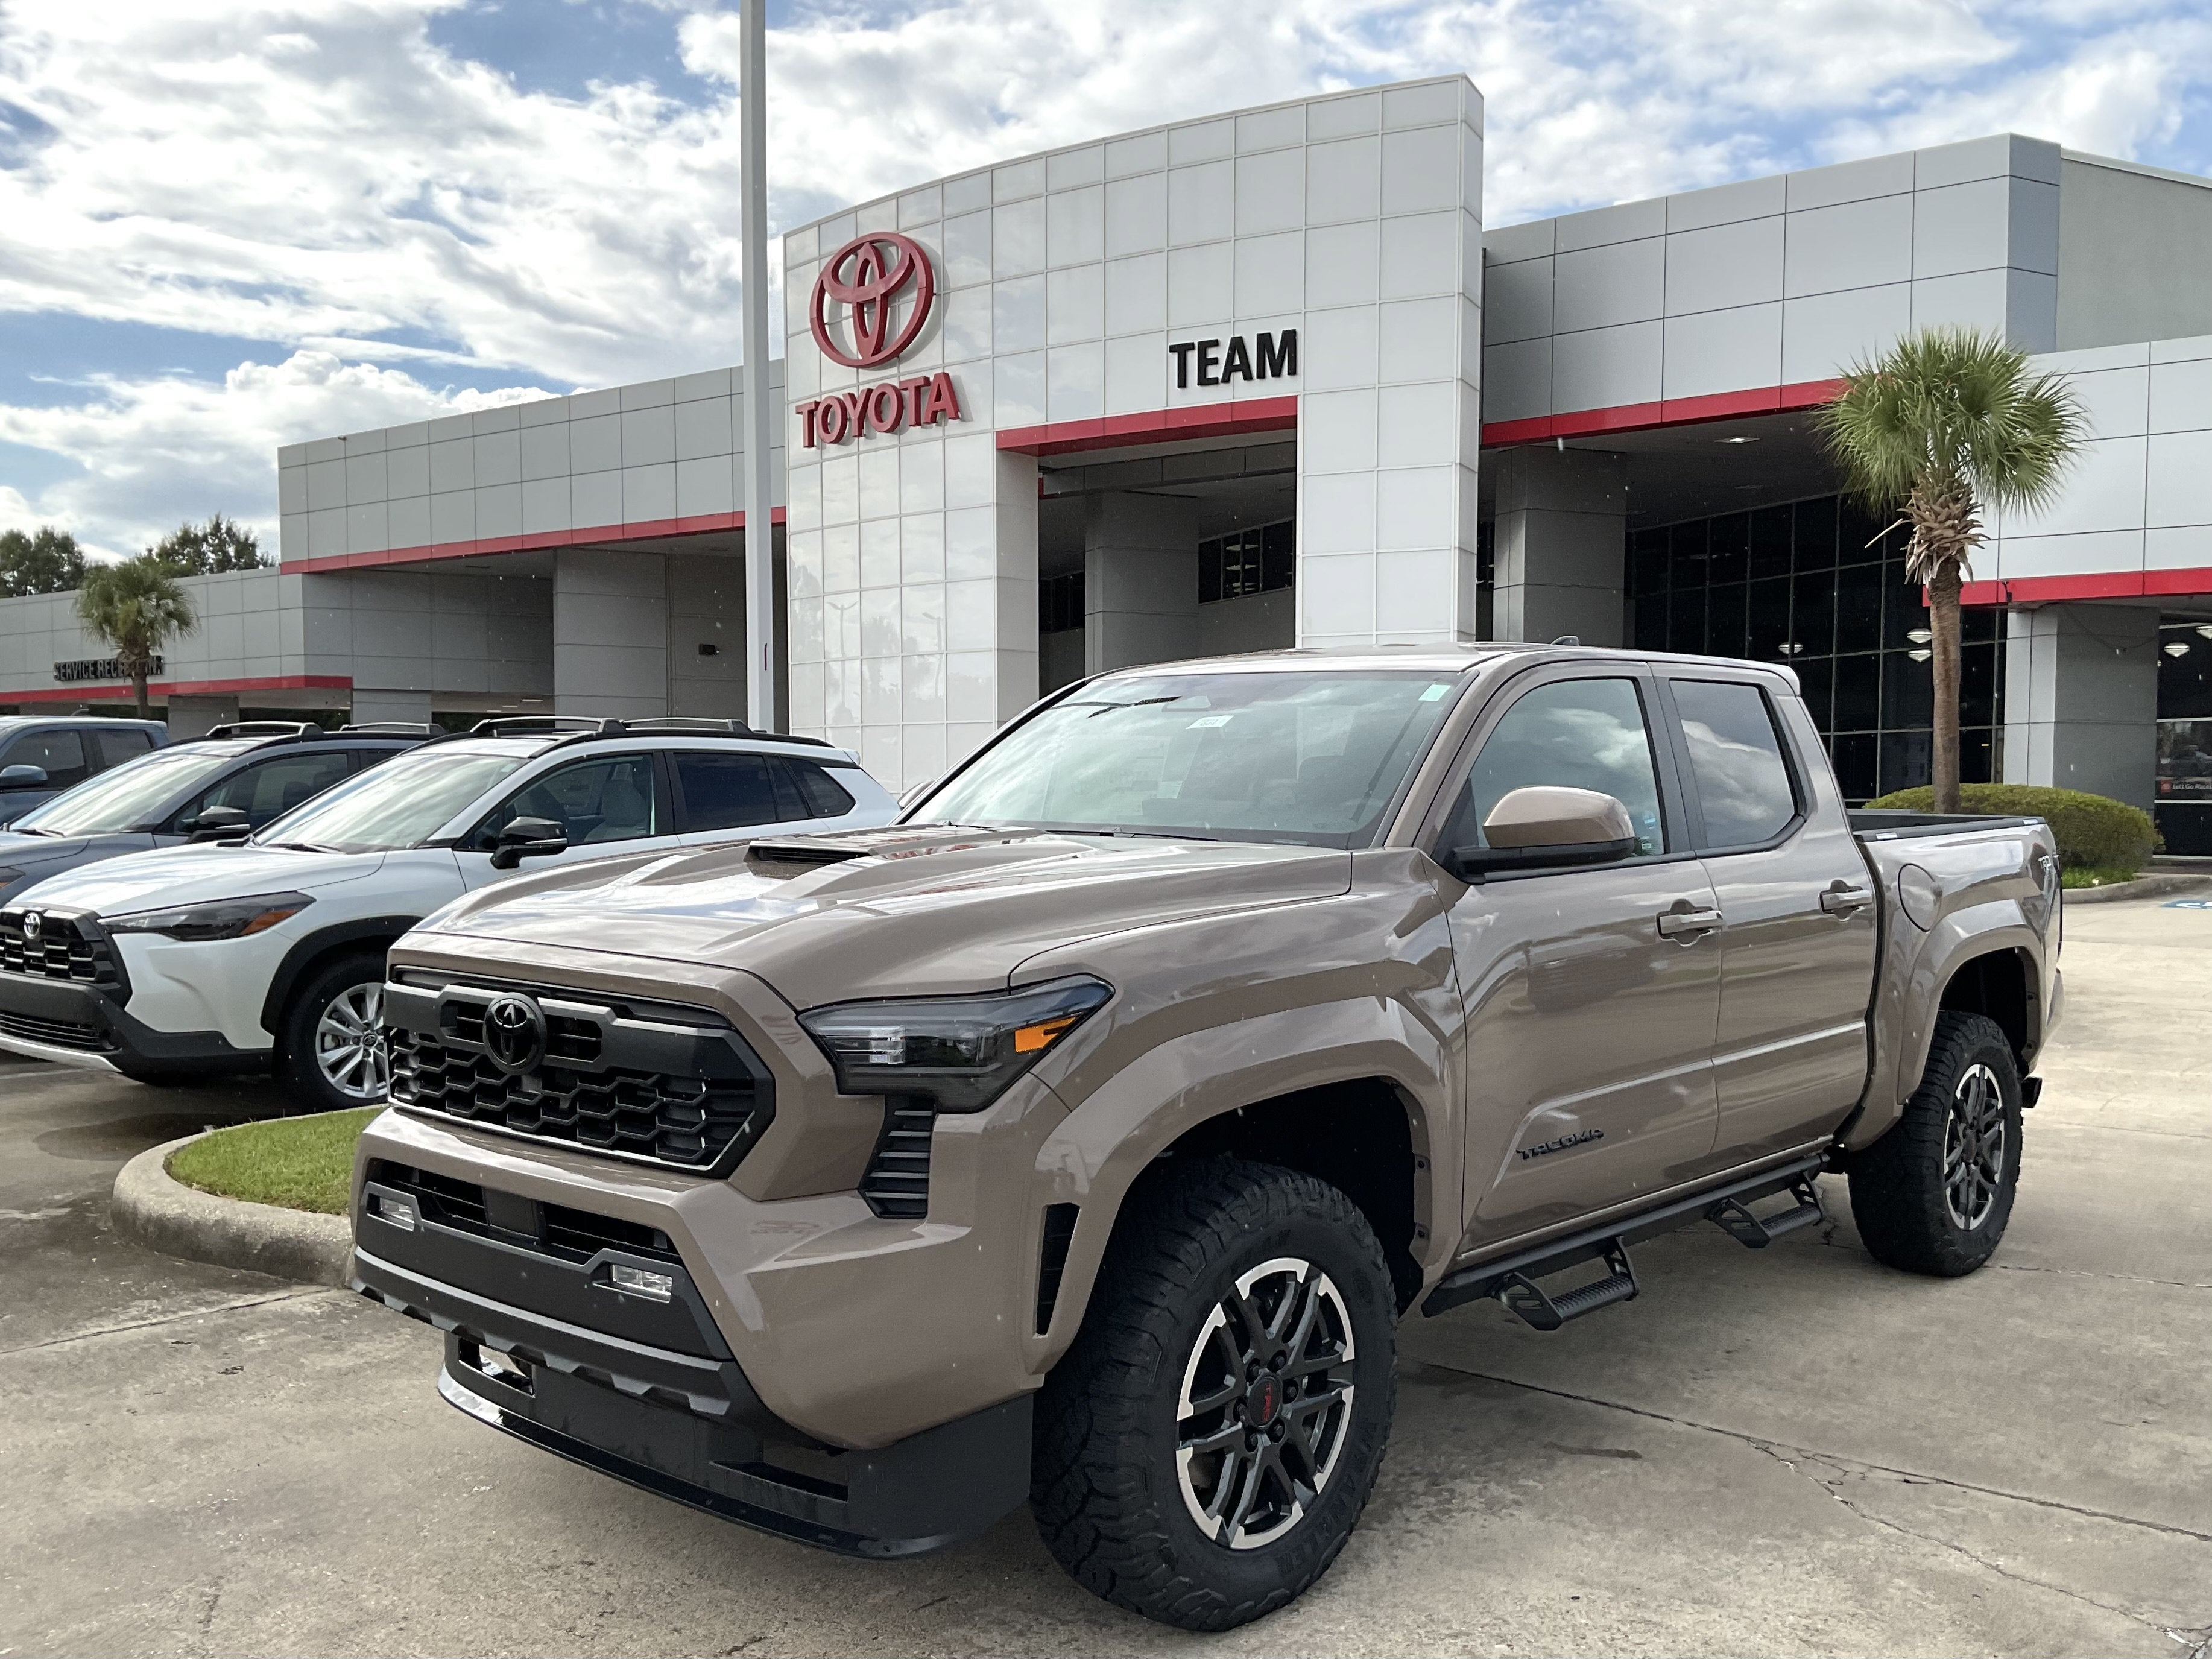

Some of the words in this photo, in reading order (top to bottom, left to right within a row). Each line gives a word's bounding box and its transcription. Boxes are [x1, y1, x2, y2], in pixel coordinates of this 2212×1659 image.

[1169, 329, 1298, 389] TEAM
[795, 372, 961, 449] TOYOTA
[54, 660, 96, 682] SERVICE
[97, 654, 164, 678] RECEN
[1515, 1128, 1604, 1160] TACOMA
[1274, 1418, 1379, 1578] WRANGLER
